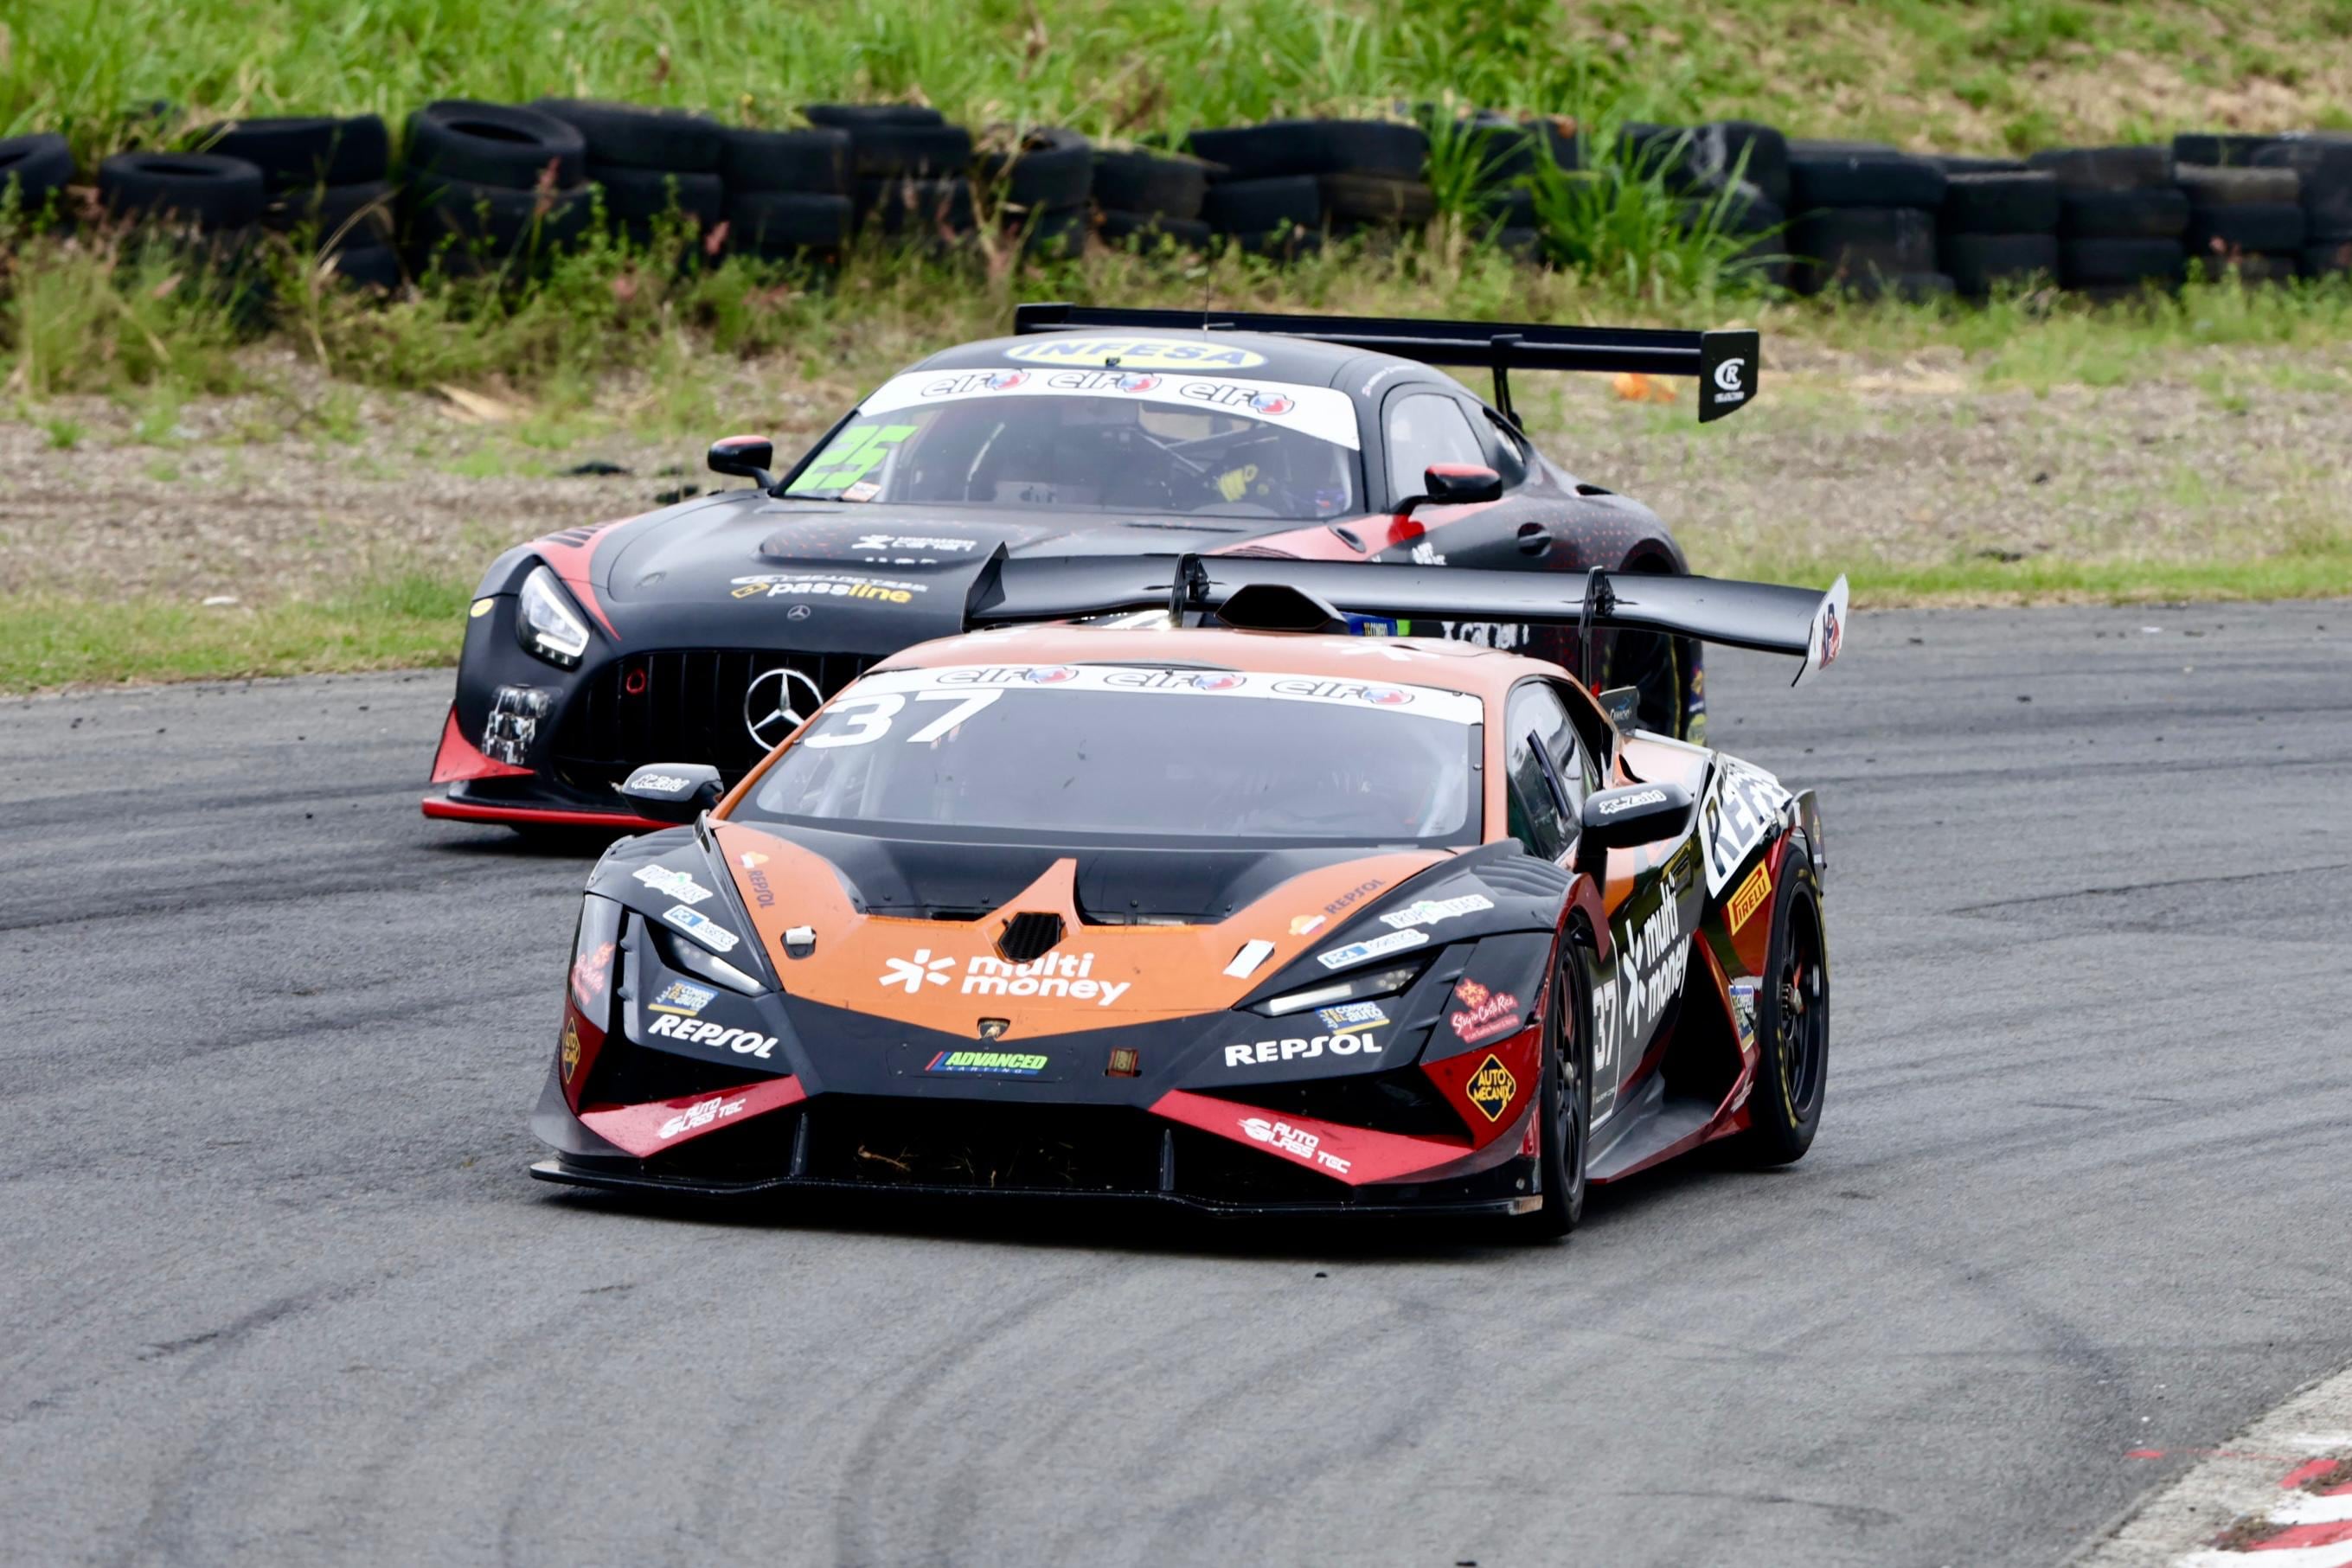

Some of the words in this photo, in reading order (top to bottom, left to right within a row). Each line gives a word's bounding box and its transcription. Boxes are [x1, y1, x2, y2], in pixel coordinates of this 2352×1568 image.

[1015, 342, 1248, 365] INFESA
[785, 425, 918, 493] 25
[766, 581, 913, 604] passline
[804, 688, 1004, 749] 37
[747, 869, 776, 909] REPSOL
[1323, 879, 1386, 914] REPSOL
[1732, 867, 1766, 929] PIRELLI
[1644, 871, 1679, 969] multi
[967, 951, 1095, 978] multi
[1648, 933, 1690, 1023] money
[961, 975, 1131, 1007] money
[648, 1014, 779, 1059] REPSOL
[1593, 978, 1616, 1072] 37
[945, 1051, 1048, 1070] ADVANCED
[1225, 1034, 1382, 1066] REPSOL
[1477, 1068, 1506, 1088] AUTO
[1272, 1122, 1319, 1149] AUTO
[1317, 1150, 1351, 1174] TEC
